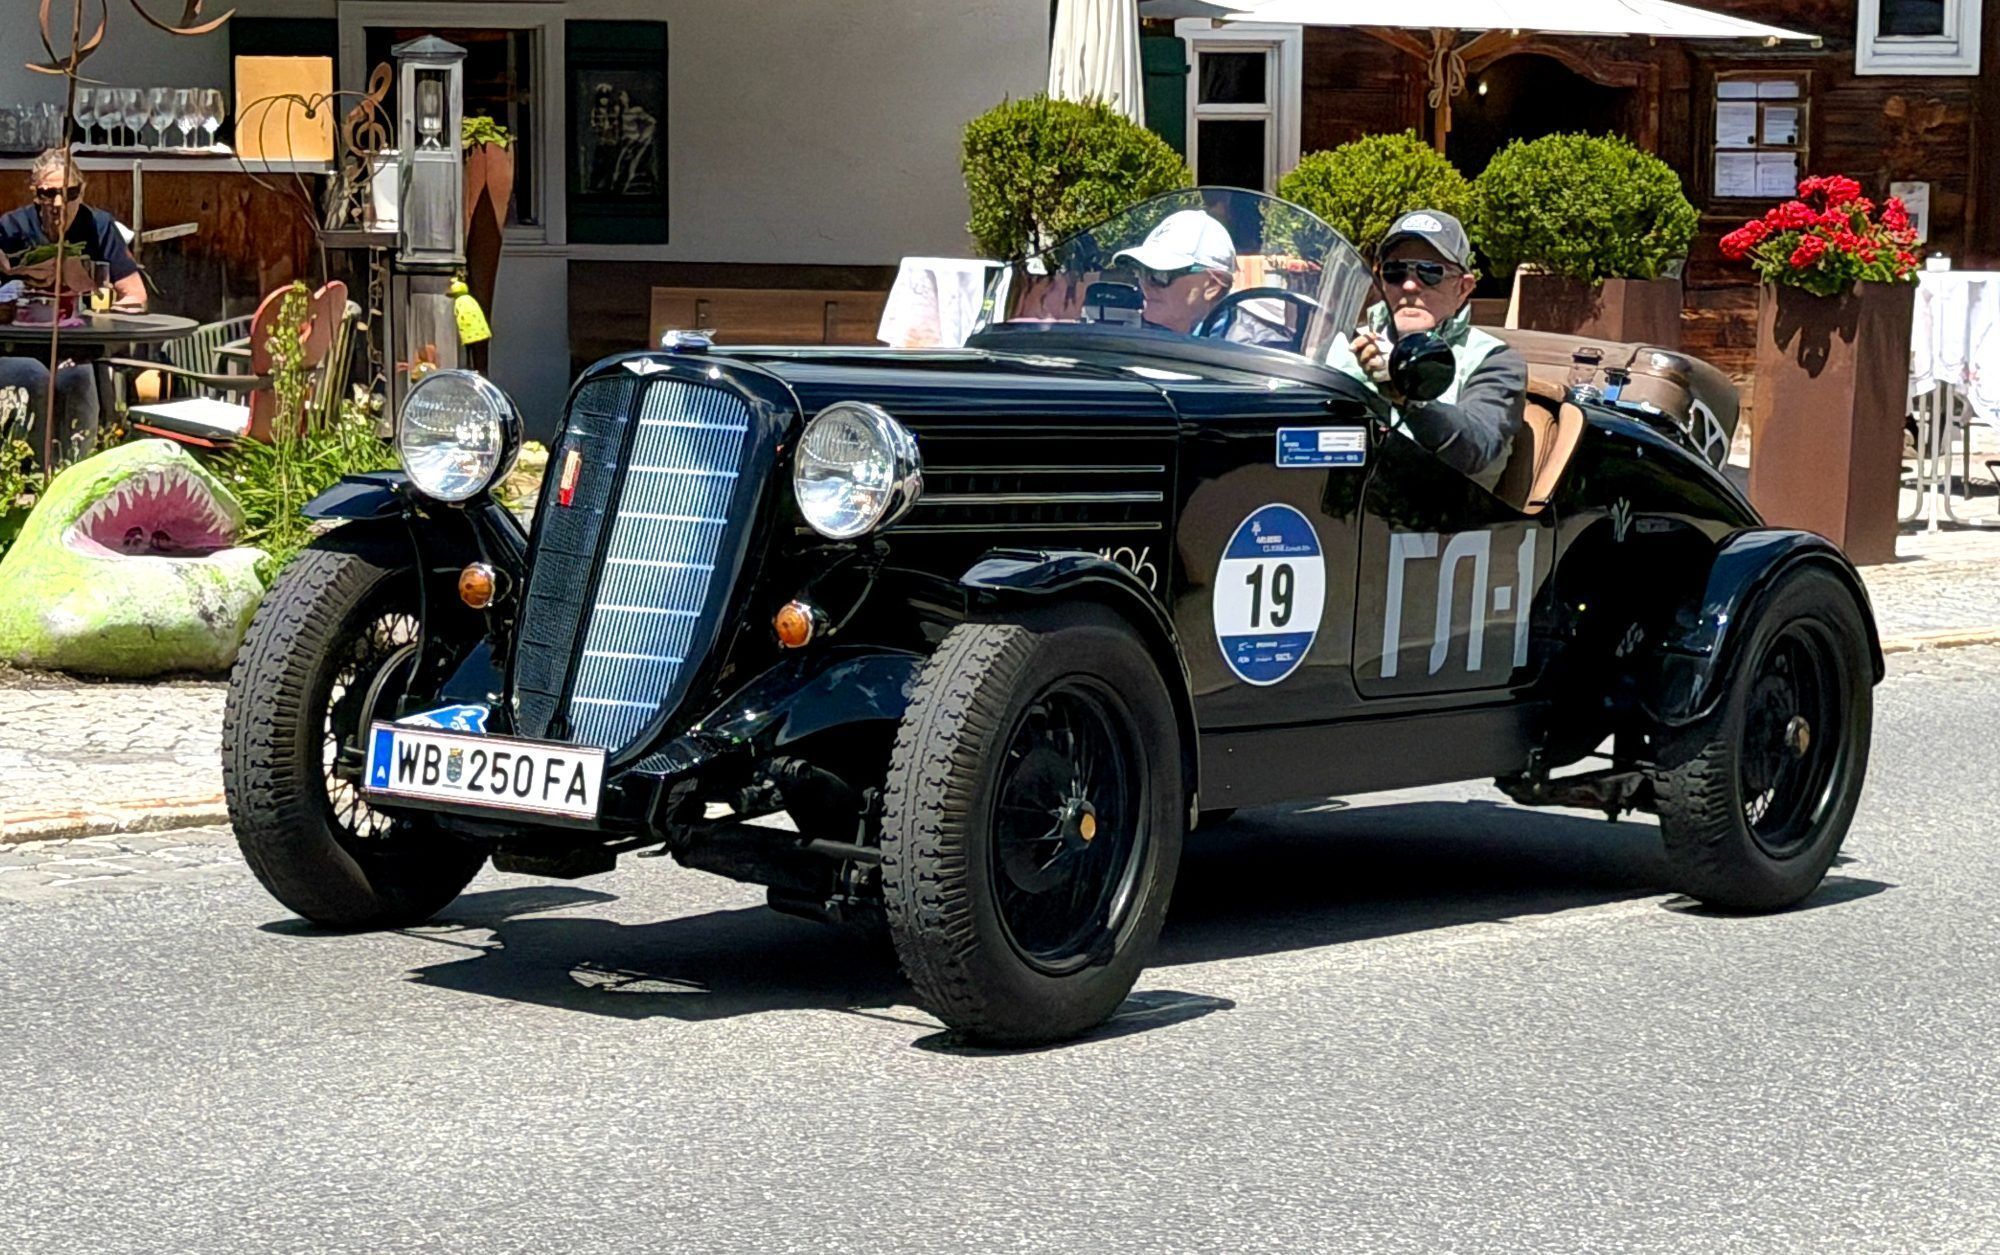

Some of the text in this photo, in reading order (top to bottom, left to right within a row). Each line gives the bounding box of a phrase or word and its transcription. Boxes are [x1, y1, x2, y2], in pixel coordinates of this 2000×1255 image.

[1245, 563, 1295, 628] 19
[397, 740, 442, 786] WB
[466, 749, 535, 798] 250
[542, 757, 588, 805] FA
